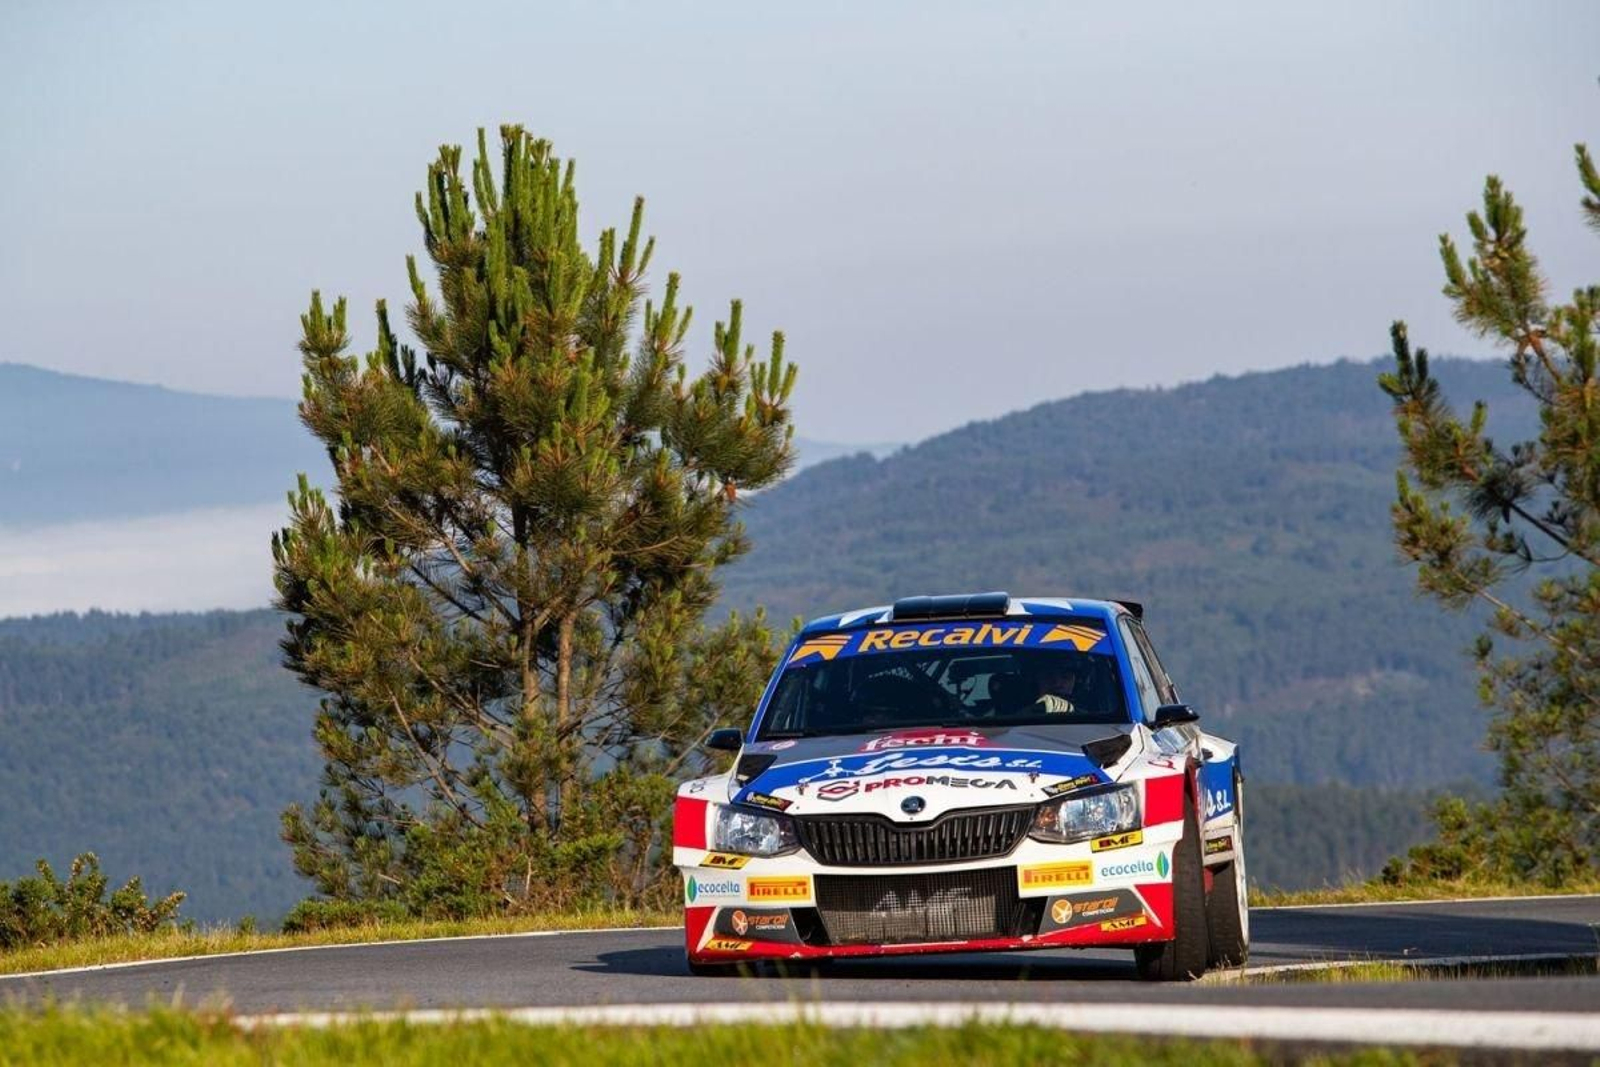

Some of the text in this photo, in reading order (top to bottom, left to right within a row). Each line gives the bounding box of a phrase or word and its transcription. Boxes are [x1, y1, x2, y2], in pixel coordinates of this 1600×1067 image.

[858, 623, 1035, 652] Recalvi
[864, 776, 1018, 793] PROMEGA
[1024, 864, 1090, 884] PIRELLI
[1101, 860, 1154, 877] ecocelta
[698, 880, 740, 893] ecocelta
[749, 881, 807, 896] PIRELLI
